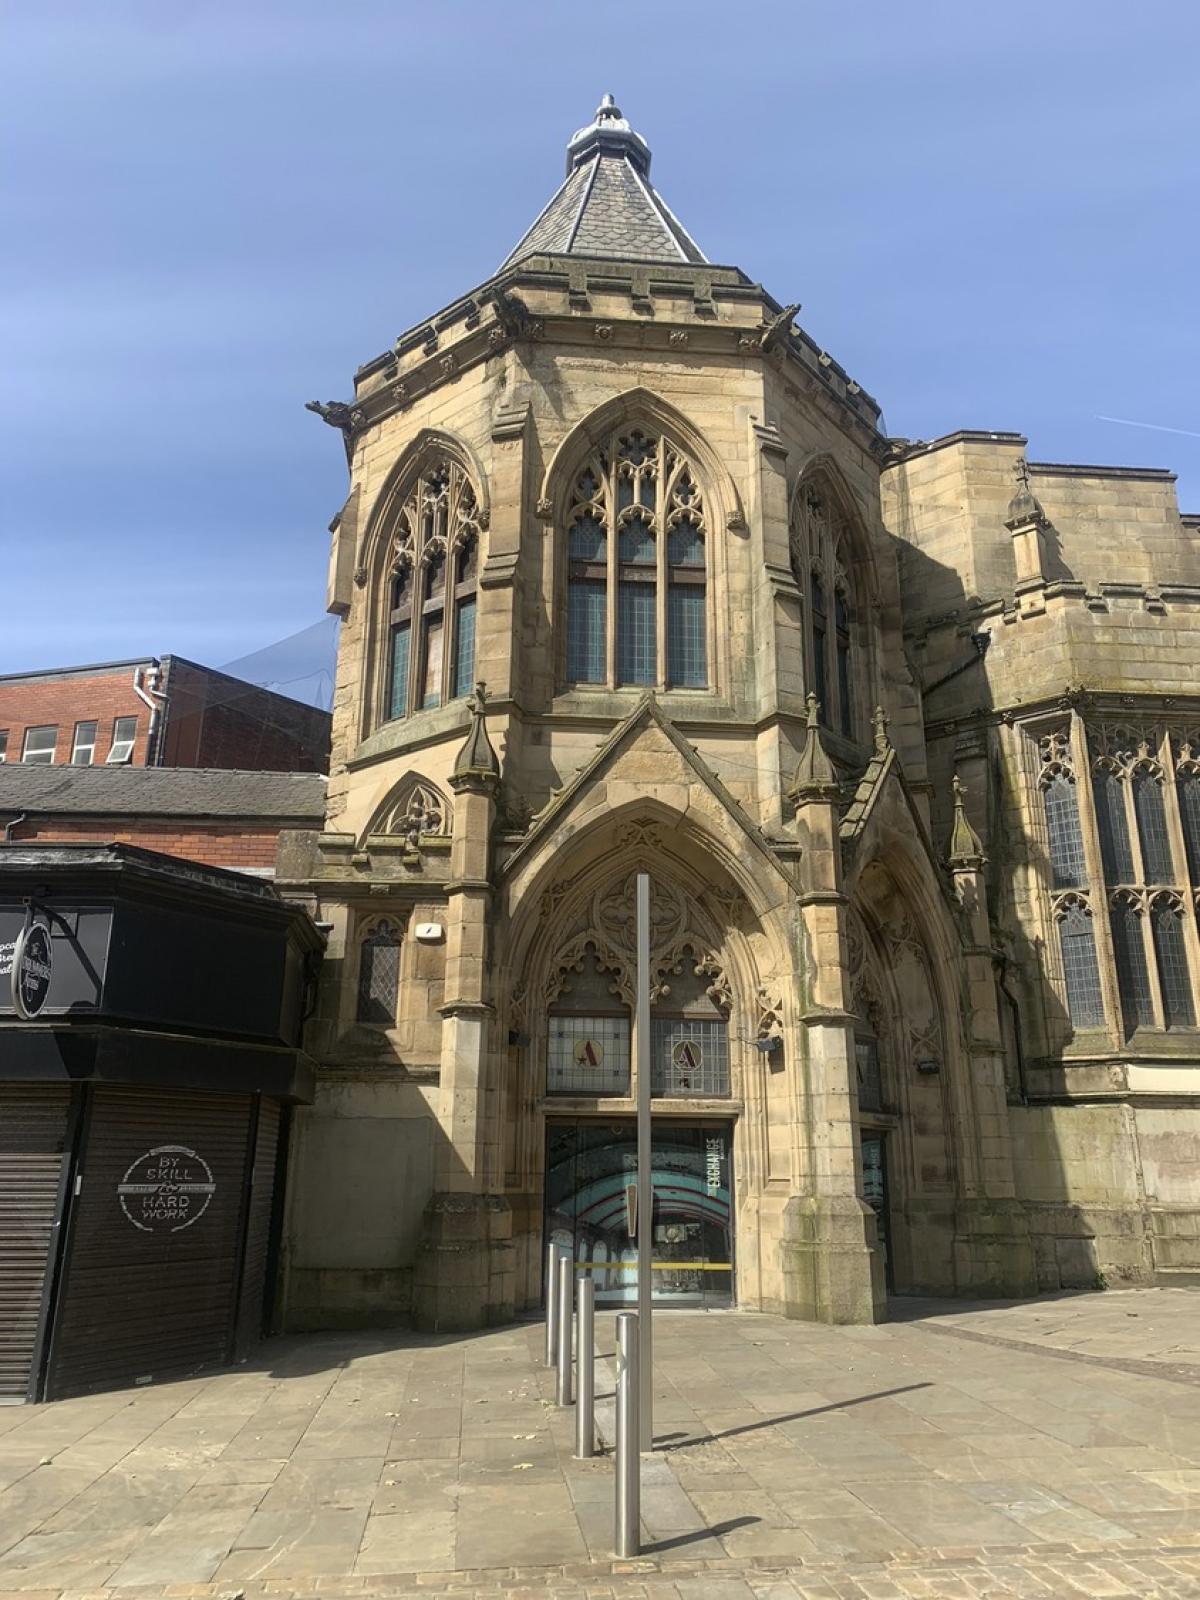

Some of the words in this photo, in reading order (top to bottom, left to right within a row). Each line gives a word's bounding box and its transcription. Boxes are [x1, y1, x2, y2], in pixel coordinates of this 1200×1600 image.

[159, 1156, 180, 1168] BY
[706, 1137, 720, 1187] EXCHANGE
[146, 1168, 193, 1180] SKILL
[142, 1195, 190, 1208] HARD
[141, 1208, 189, 1220] WORK
